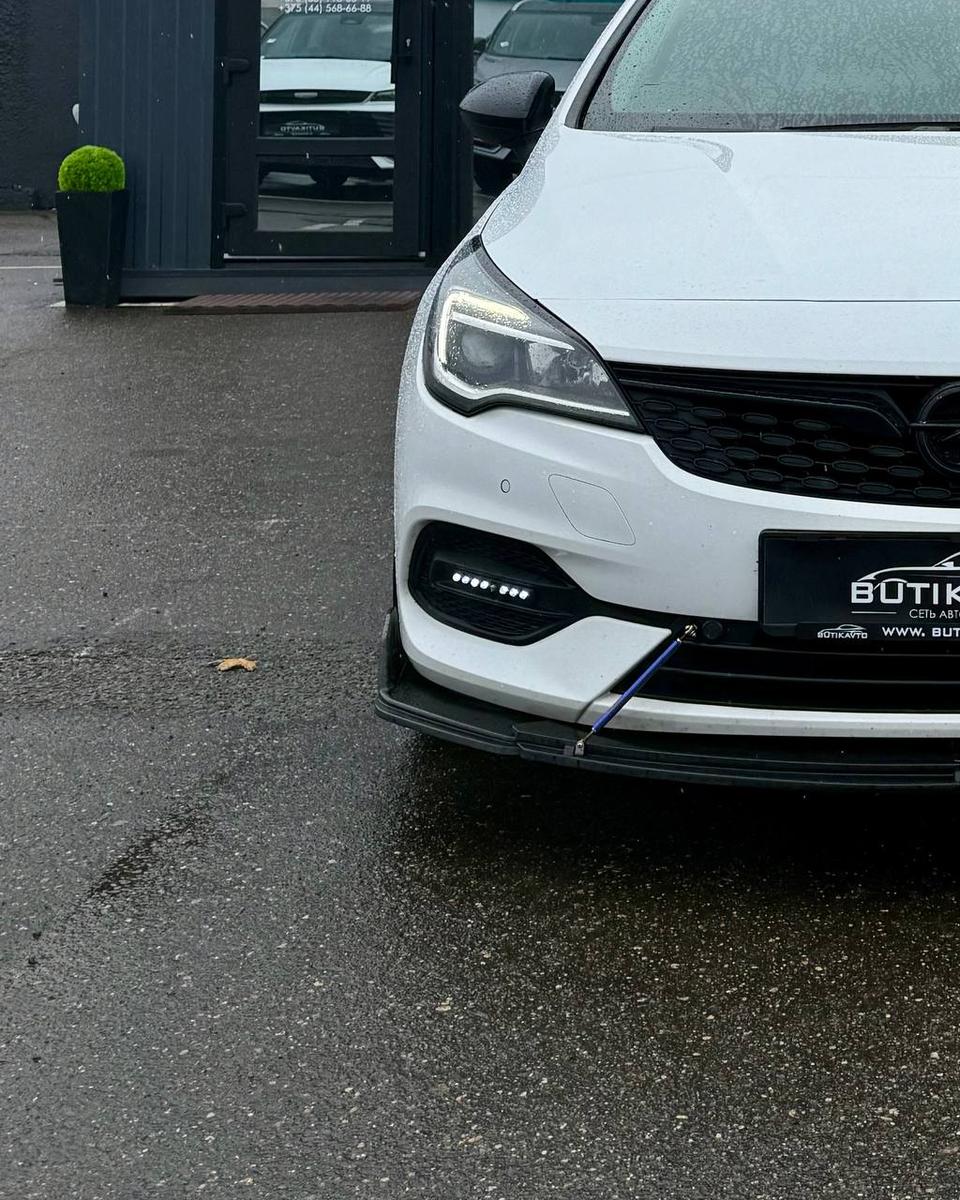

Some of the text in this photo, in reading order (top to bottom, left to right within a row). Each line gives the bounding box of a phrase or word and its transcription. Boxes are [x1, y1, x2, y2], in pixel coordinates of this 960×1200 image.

[279, 3, 372, 14] +375 (44) 568-66-88
[909, 608, 936, 619] СЕТЬ
[817, 631, 868, 639] BUTIKAVTO
